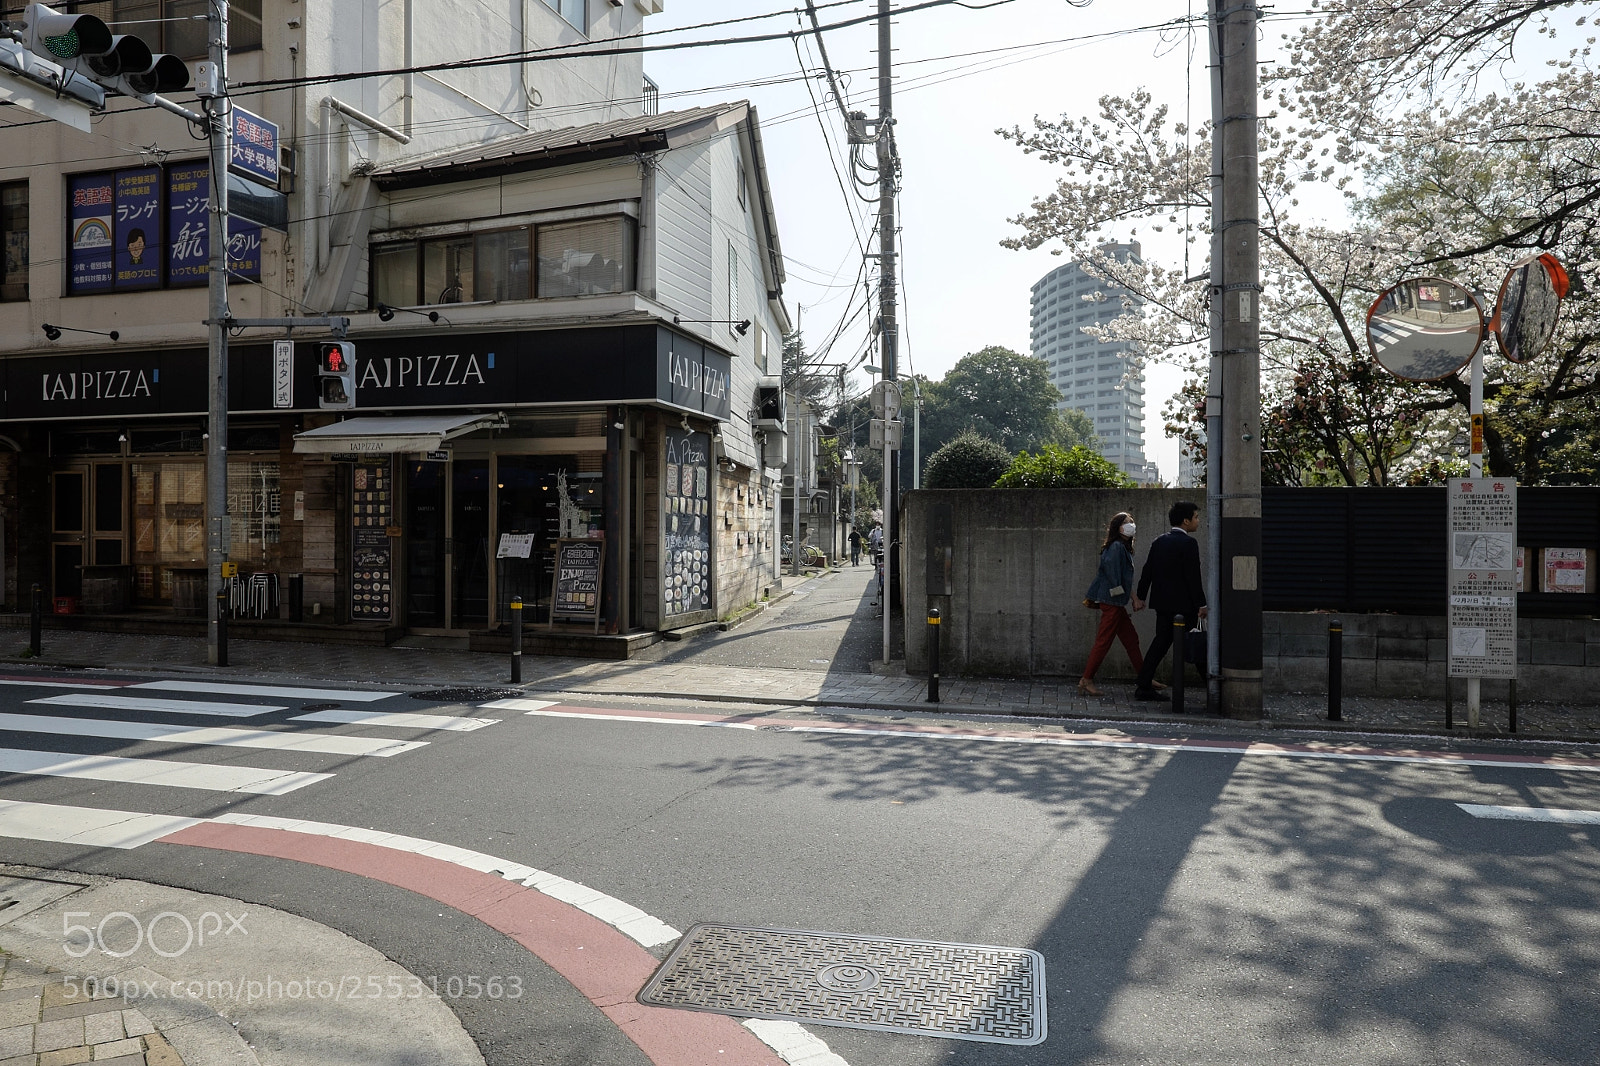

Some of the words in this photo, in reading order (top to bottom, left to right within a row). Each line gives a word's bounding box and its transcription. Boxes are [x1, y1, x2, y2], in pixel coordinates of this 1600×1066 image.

[236, 116, 274, 151] 英語塾
[233, 144, 277, 174] 大学受験
[118, 174, 157, 187] 大学受験英語
[171, 171, 191, 180] TOEIC
[74, 186, 112, 207] 英語塾
[118, 186, 151, 197] 小中高英語
[171, 182, 198, 192] 各種留学
[117, 200, 158, 221] ランゲ
[172, 222, 207, 261] 航
[278, 346, 289, 402] 押ボタン式
[398, 353, 486, 388] PIZZA
[692, 360, 726, 401] PIZZA
[81, 369, 152, 399] PIZZA
[559, 569, 585, 581] ENJOY
[573, 580, 596, 591] PIZZA
